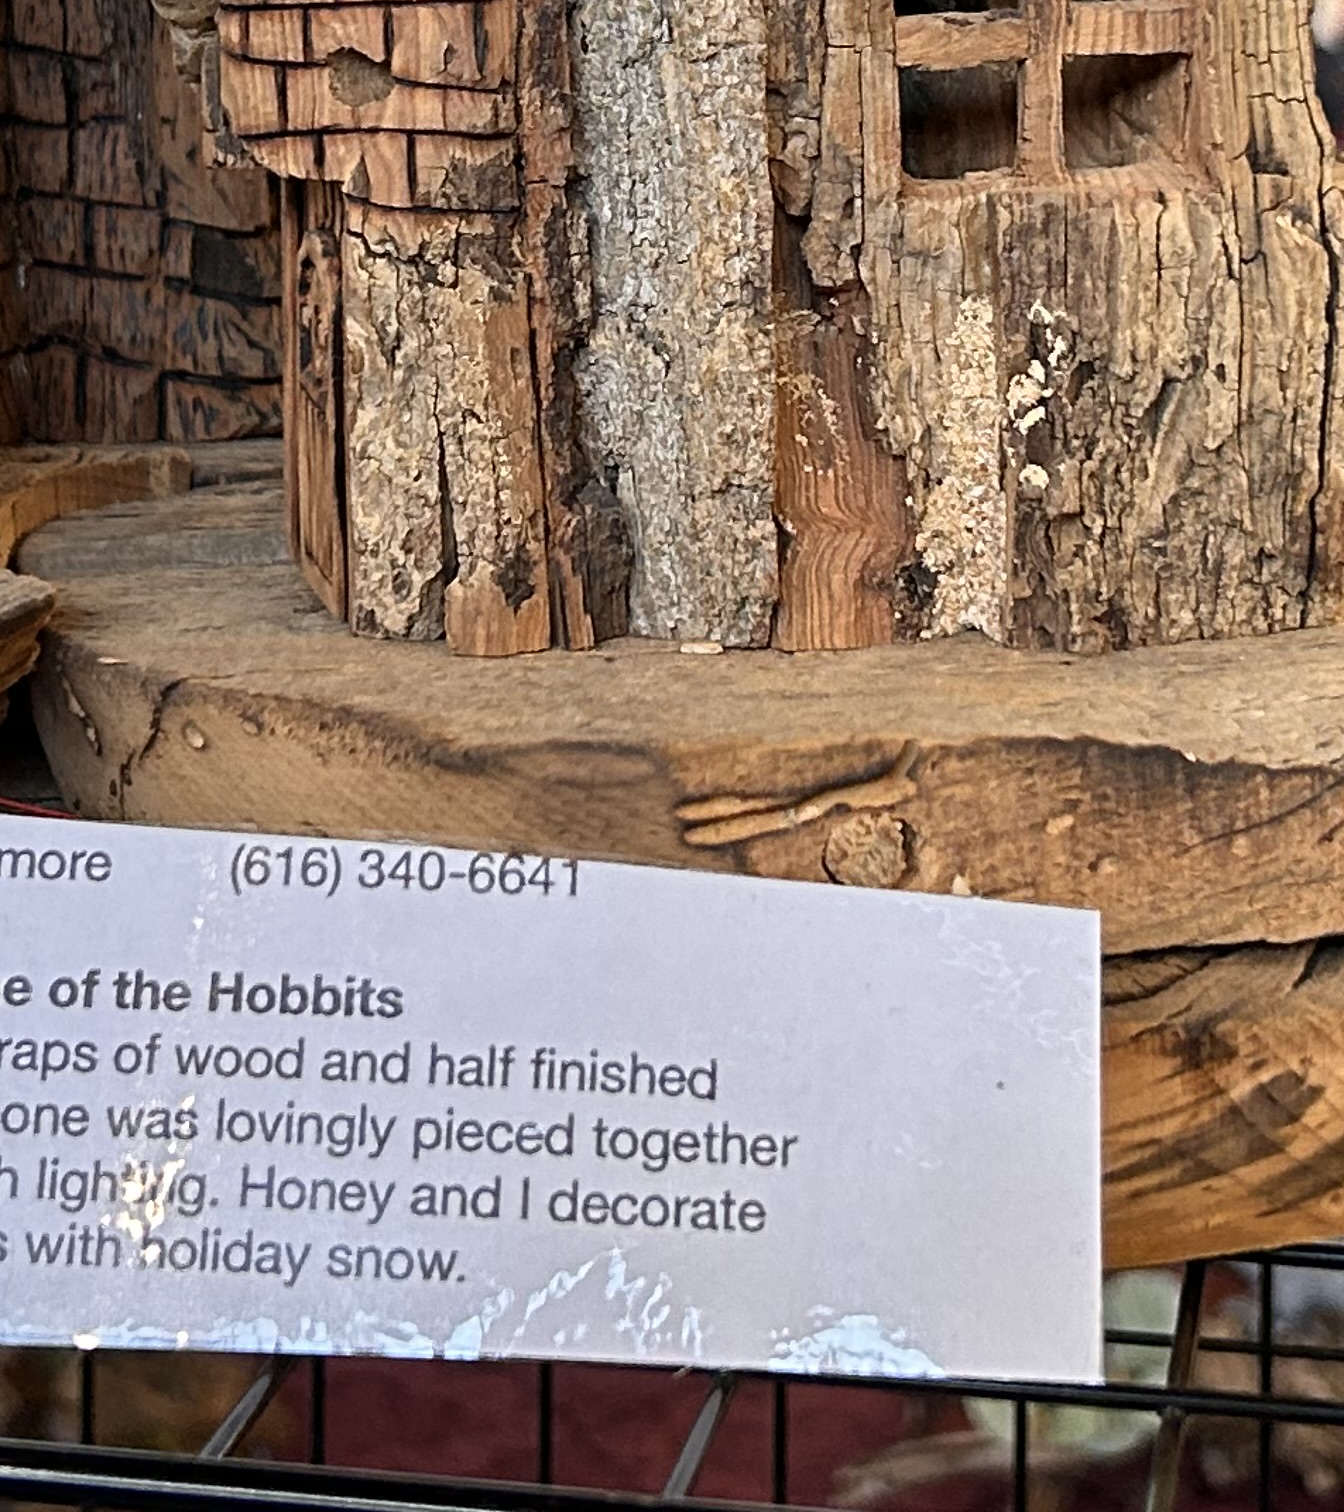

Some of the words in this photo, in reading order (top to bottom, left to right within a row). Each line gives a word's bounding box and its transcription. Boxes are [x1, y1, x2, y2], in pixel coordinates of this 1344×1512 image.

[230, 843, 342, 899] (616)
[357, 849, 578, 897] 340-6641
[47, 967, 102, 1010] of
[112, 968, 192, 1013] the
[207, 970, 404, 1019] Hobbits
[112, 1032, 163, 1076] of
[174, 1036, 306, 1081] wood
[320, 1040, 411, 1086] and
[427, 1041, 517, 1090] half
[529, 1046, 718, 1102] finished
[0, 1101, 90, 1138] one
[106, 1105, 199, 1141] was
[215, 1097, 398, 1160] lovingly
[412, 1106, 575, 1163] pieced
[591, 1117, 799, 1174] together
[239, 1163, 396, 1226] Honey
[409, 1175, 502, 1220] and
[519, 1176, 531, 1221] I
[547, 1178, 767, 1234] decorate
[25, 1222, 122, 1268] with
[138, 1224, 313, 1286] holiday
[326, 1244, 466, 1283] snow.
